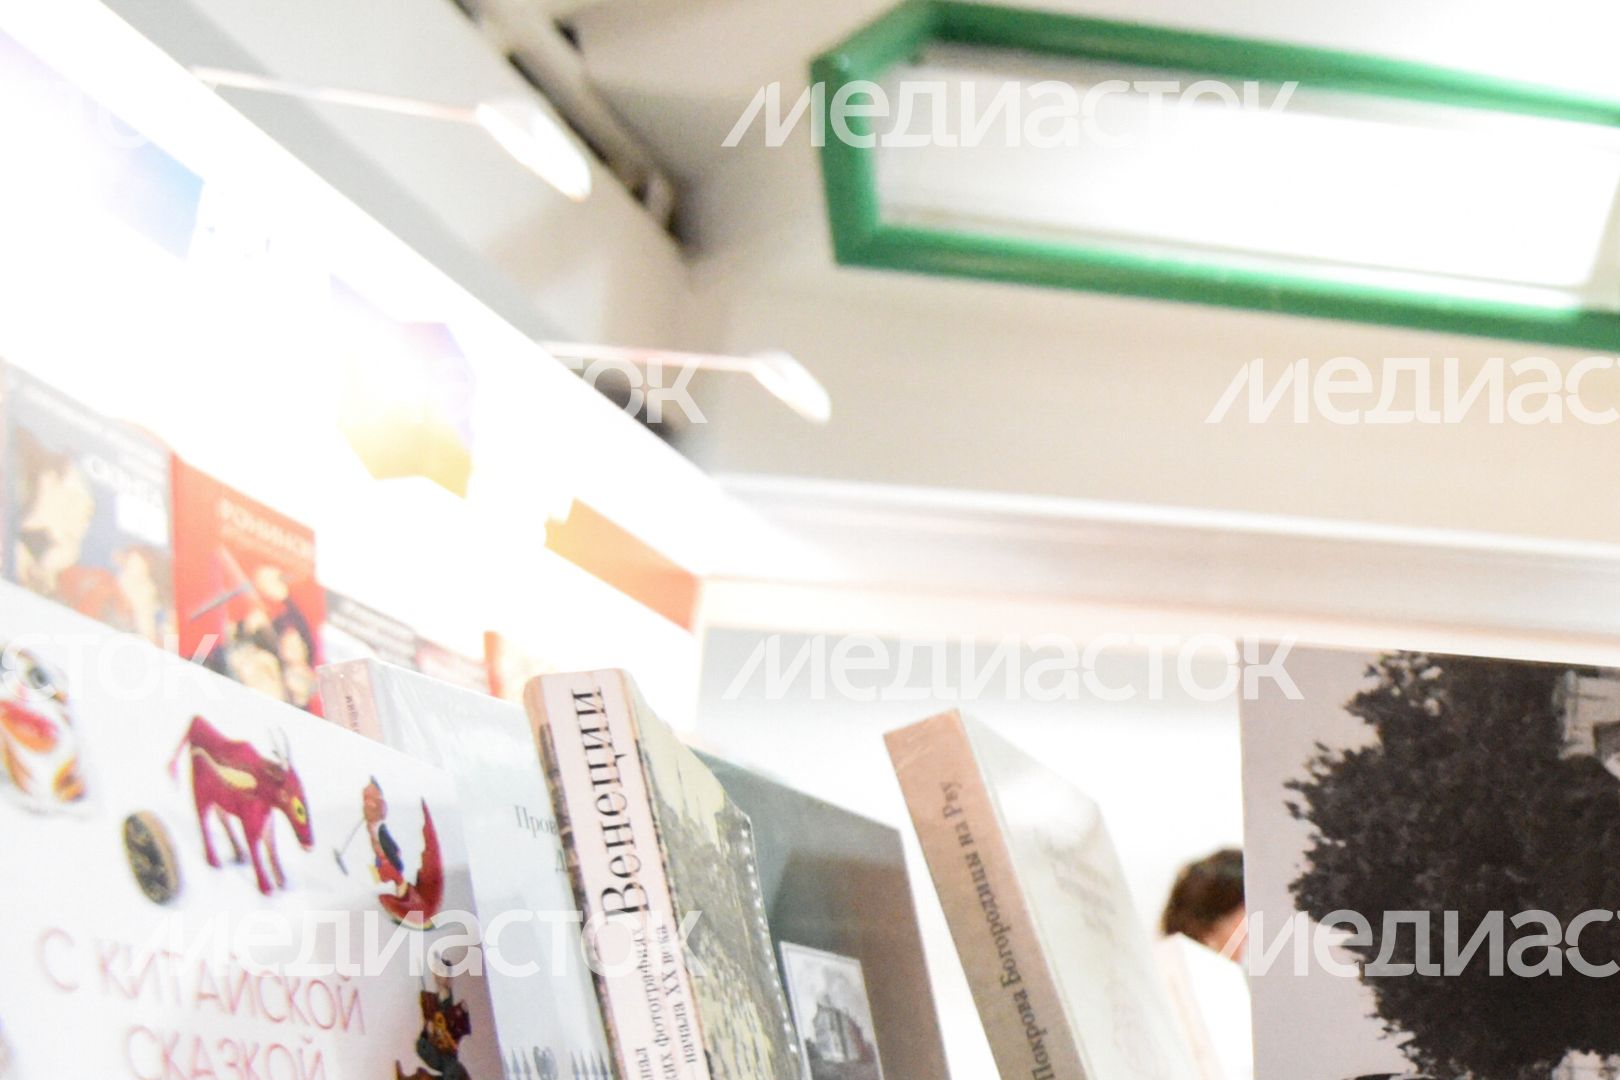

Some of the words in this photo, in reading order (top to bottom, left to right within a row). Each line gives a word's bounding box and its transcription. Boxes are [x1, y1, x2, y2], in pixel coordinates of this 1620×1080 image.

[571, 685, 649, 918] Венеции
[939, 779, 965, 820] Рву
[955, 821, 976, 848] на
[653, 923, 675, 965] века
[964, 849, 1024, 989] Богородицы
[35, 926, 79, 994] С
[97, 936, 367, 1035] КИТАЙСКОЙ
[631, 926, 673, 1047] фотографиях
[670, 1001, 697, 1063] начала
